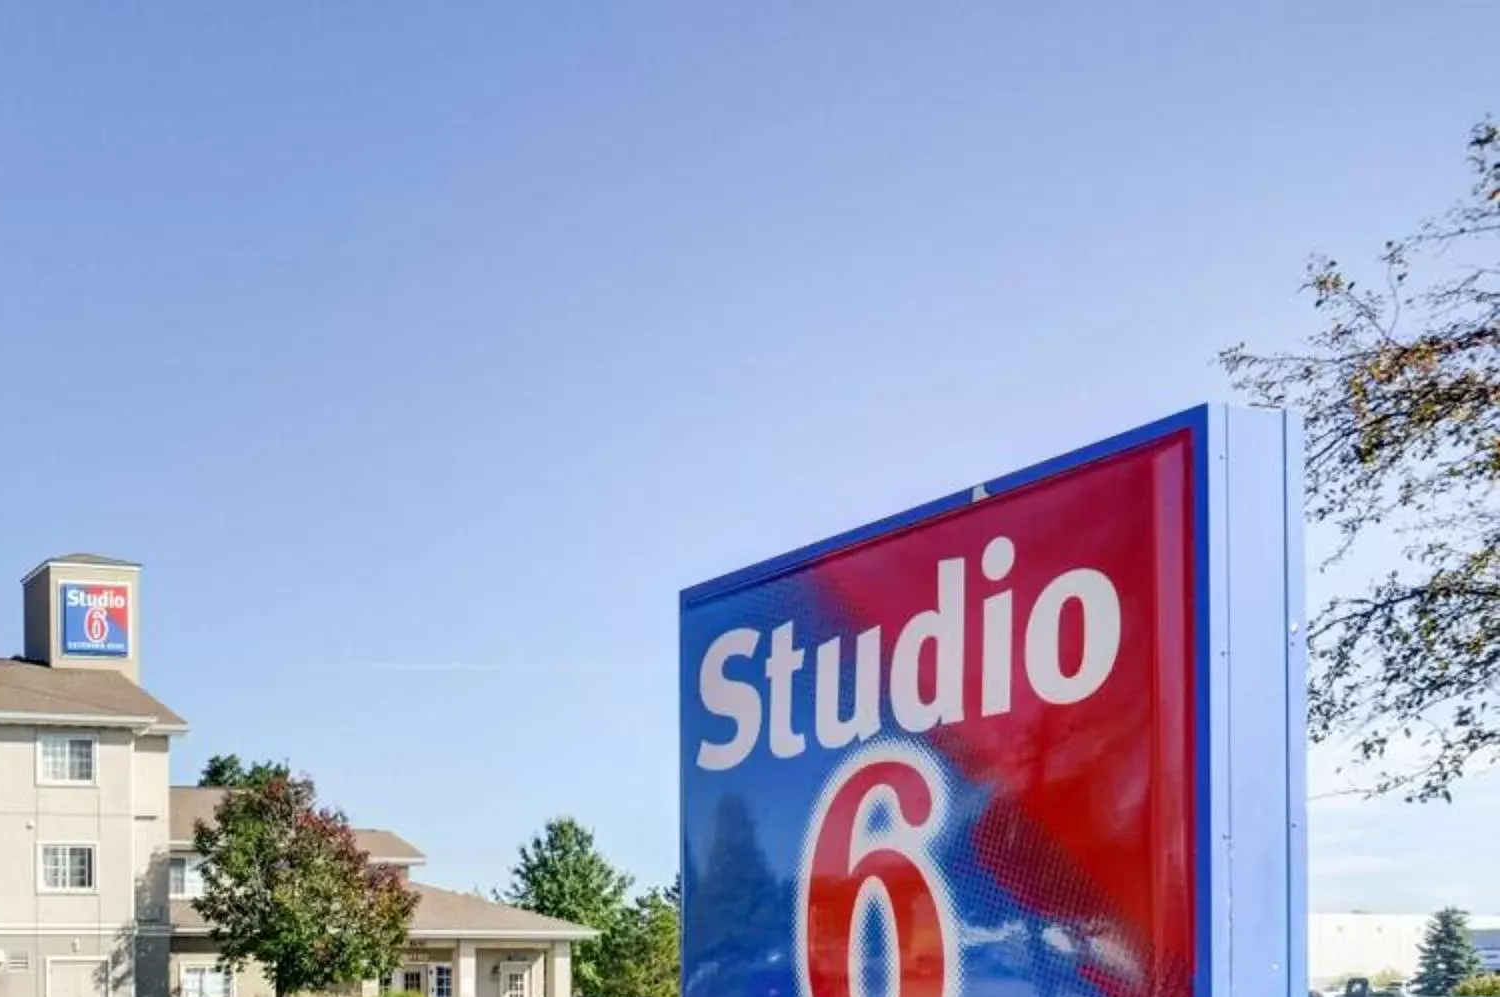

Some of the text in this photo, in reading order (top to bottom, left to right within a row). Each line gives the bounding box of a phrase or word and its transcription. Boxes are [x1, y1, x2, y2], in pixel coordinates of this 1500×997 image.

[67, 588, 126, 608] Studio
[85, 607, 109, 642] 6
[695, 536, 1122, 772] Studio
